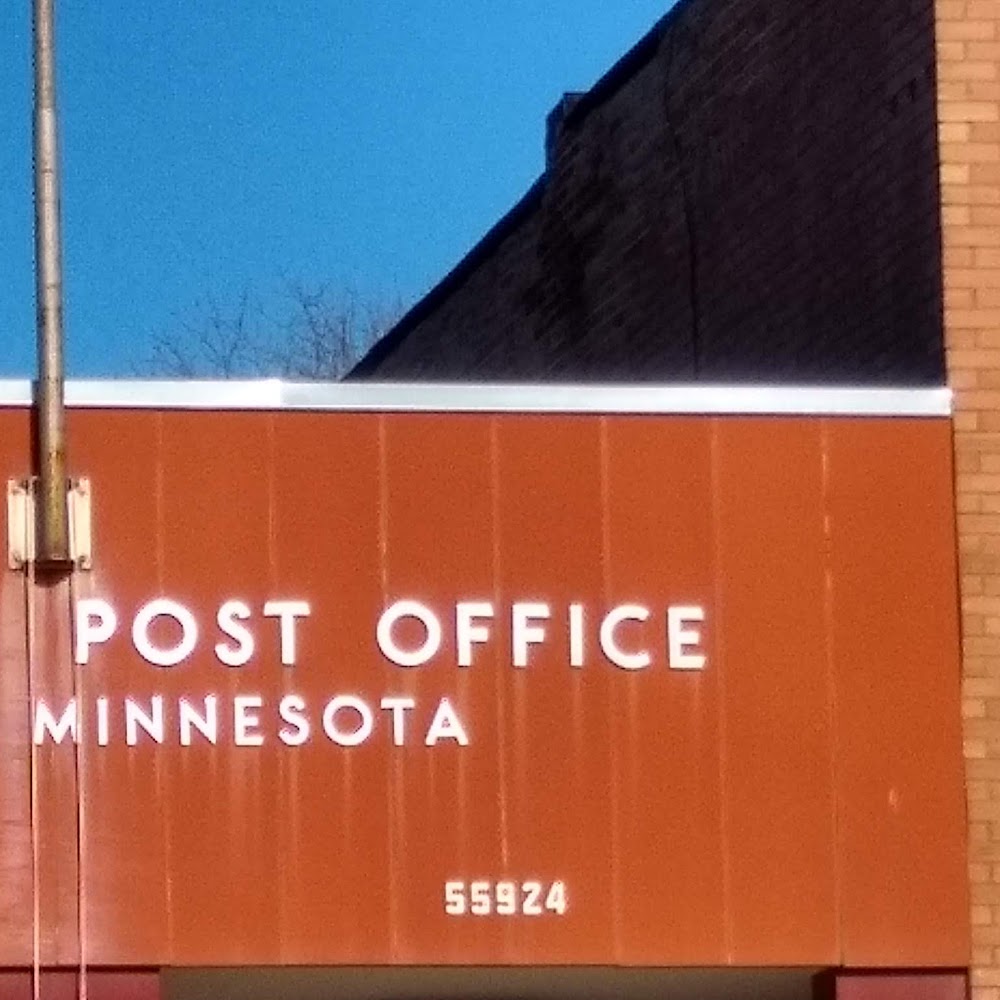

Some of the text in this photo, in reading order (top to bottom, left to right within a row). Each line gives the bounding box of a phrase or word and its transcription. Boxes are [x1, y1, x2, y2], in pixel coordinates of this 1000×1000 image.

[74, 599, 311, 667] POST
[376, 599, 706, 670] OFFICE
[32, 693, 470, 747] MINNESOTA
[445, 881, 566, 915] 55924
